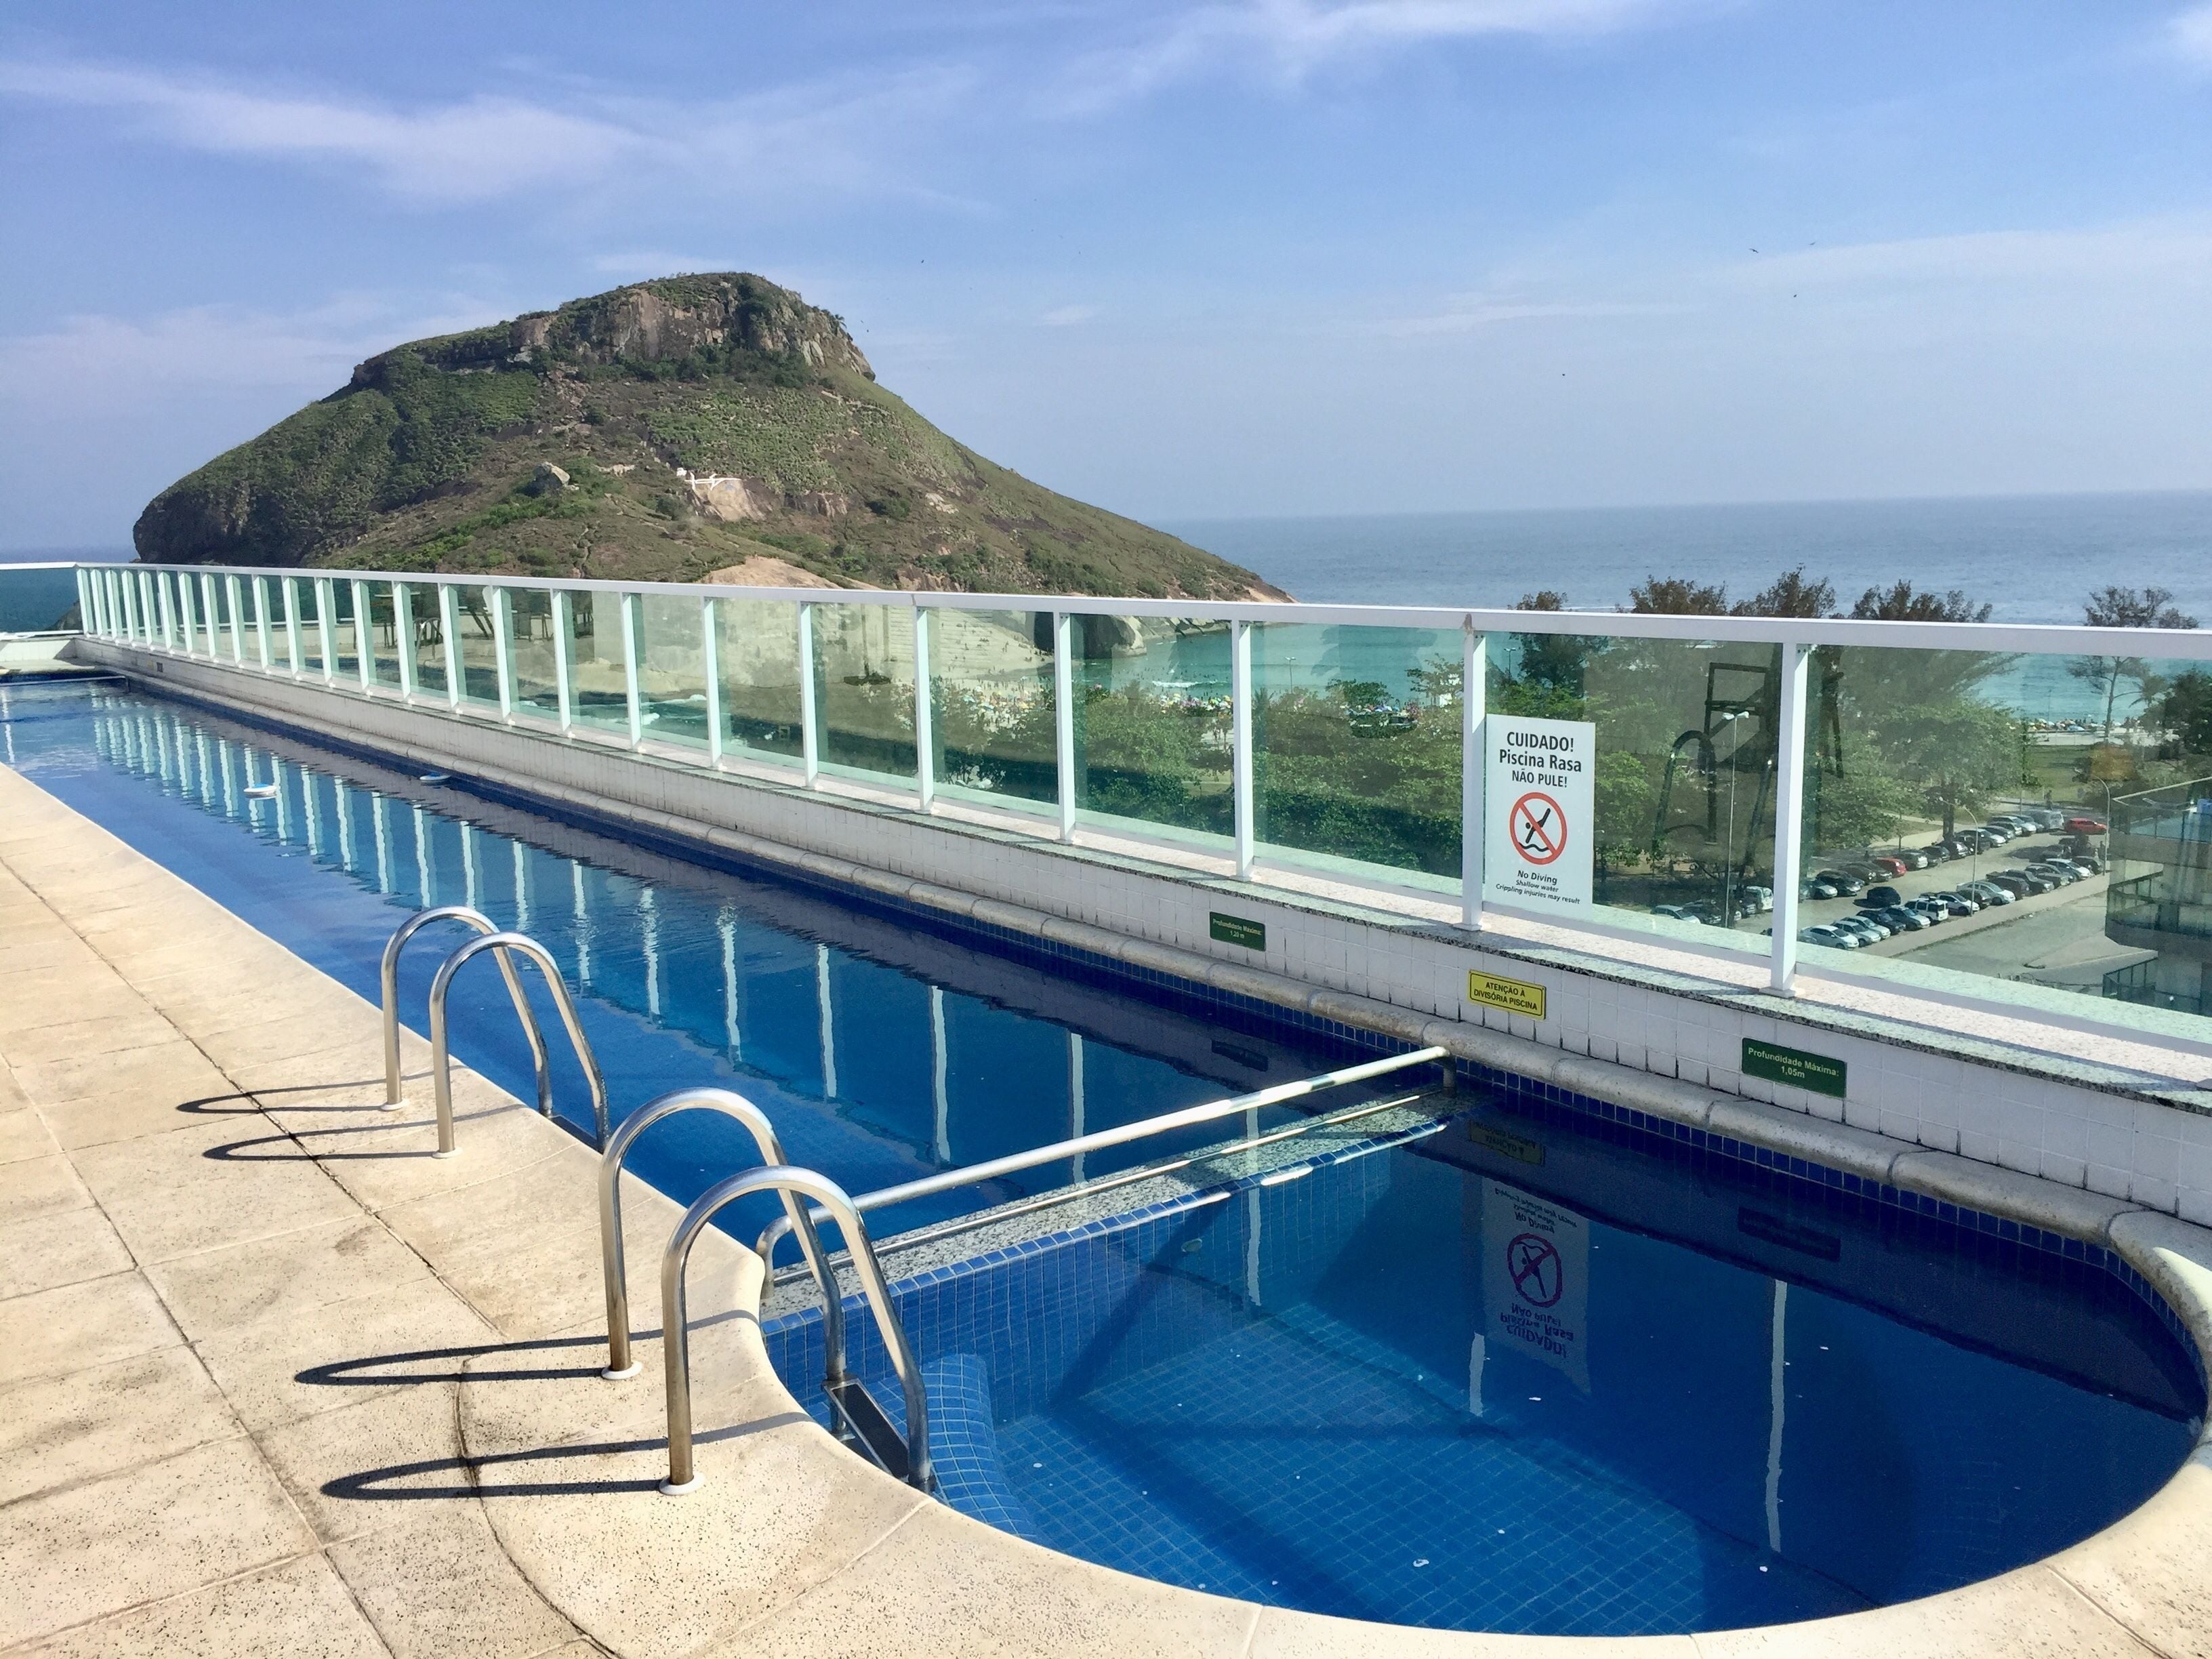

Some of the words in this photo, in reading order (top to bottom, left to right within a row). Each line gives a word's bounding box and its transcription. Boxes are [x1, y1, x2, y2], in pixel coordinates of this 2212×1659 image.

[1507, 731, 1574, 752] CUIDADO!
[1499, 749, 1544, 768] Piscina
[1549, 754, 1582, 773] Rasa
[1512, 768, 1534, 783] NÃO
[1538, 773, 1568, 788] PULE!
[1515, 880, 1540, 889] Shallow
[1517, 869, 1529, 879] No
[1530, 872, 1558, 886] Diving
[1496, 883, 1523, 895] Crippling
[1523, 888, 1547, 898] injuries
[1547, 894, 1561, 902] may
[1561, 896, 1580, 905] result
[1473, 988, 1508, 1004] DIVISÓRIA
[1509, 997, 1538, 1010] PISCINA
[1485, 981, 1519, 996] ATENÇÃO
[1519, 987, 1525, 998] À
[1748, 1047, 1803, 1067] Profundidade
[1804, 1060, 1839, 1077] Máxima:
